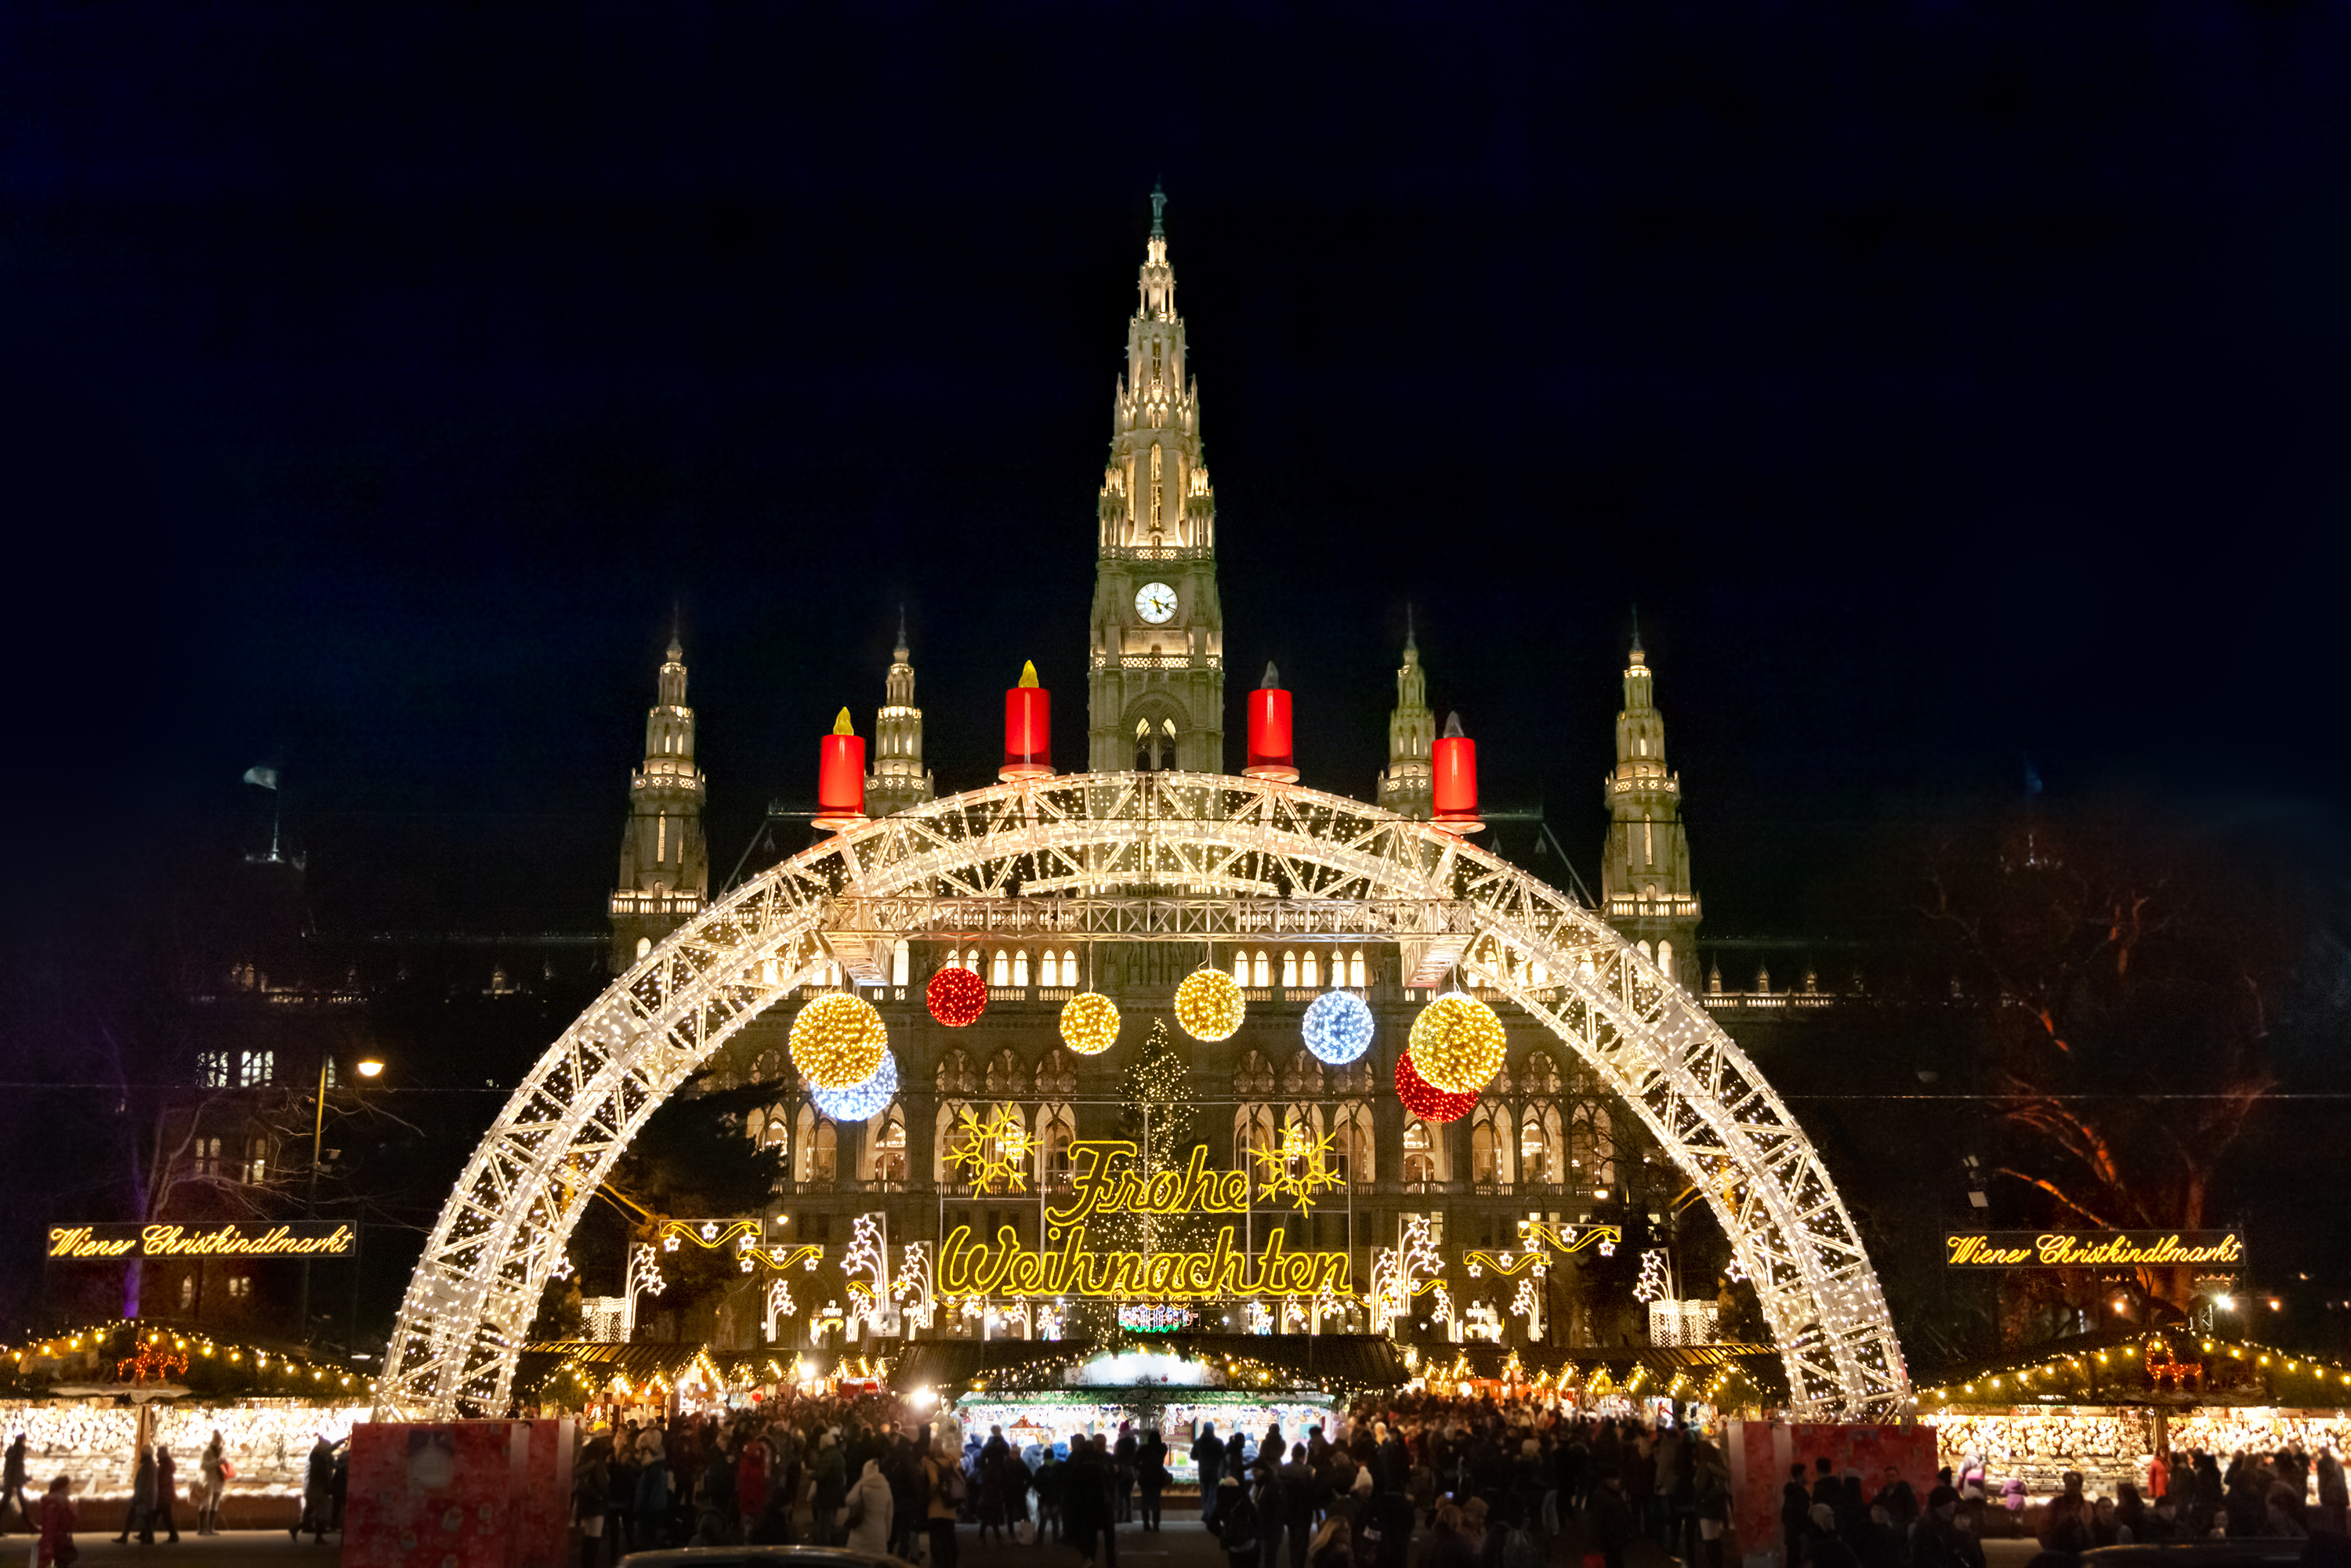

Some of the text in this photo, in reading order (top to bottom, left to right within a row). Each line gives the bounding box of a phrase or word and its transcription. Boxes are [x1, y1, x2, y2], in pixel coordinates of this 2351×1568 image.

[1045, 1140, 1250, 1226] Frohe
[49, 1224, 353, 1257] Wiener Christkindlmarkt
[939, 1225, 1353, 1296] Weihnachten
[1947, 1233, 2243, 1264] Wiener Christkindlmarkt
